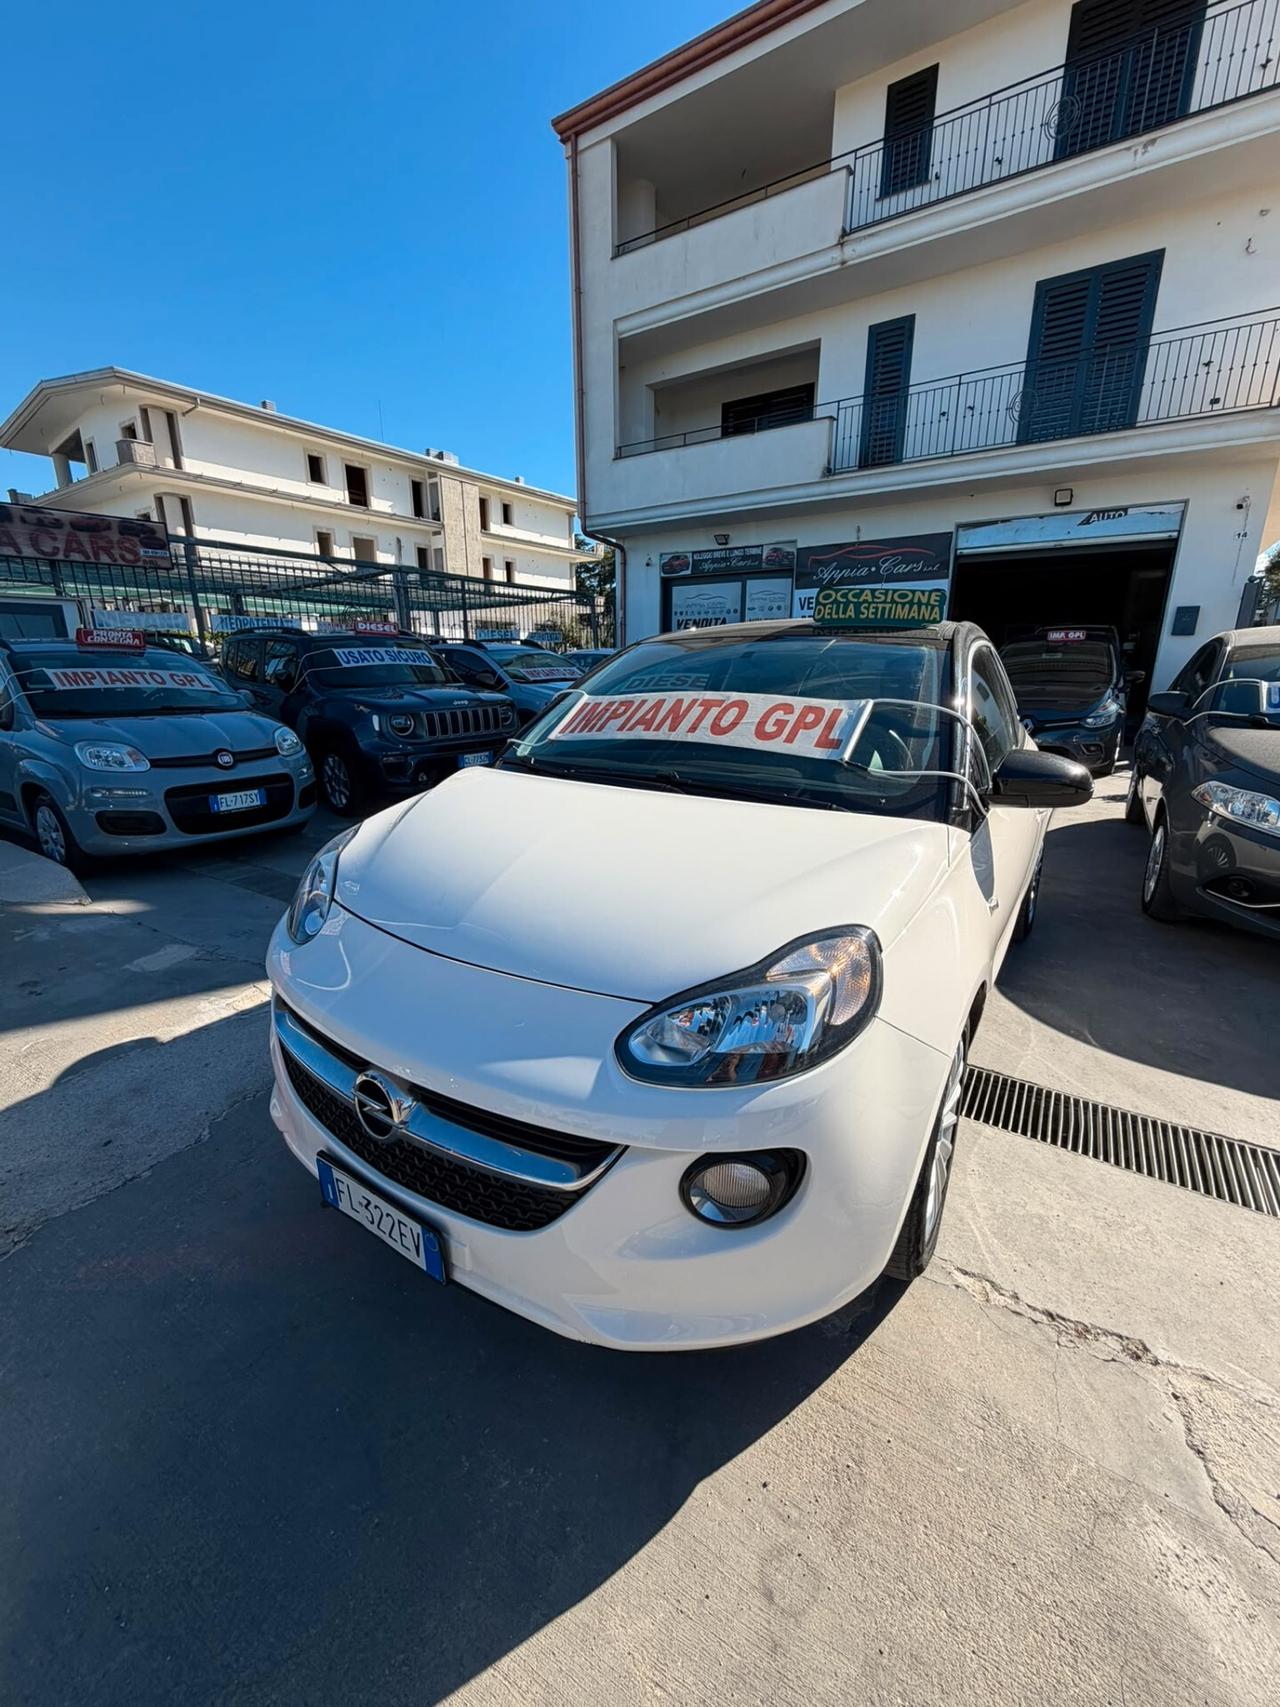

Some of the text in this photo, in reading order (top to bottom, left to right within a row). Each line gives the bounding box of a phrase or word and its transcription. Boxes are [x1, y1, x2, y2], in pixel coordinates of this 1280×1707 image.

[1236, 531, 1248, 539] 14
[30, 529, 141, 564] CARS
[813, 562, 870, 585] Appia
[879, 556, 924, 575] Cars
[818, 589, 942, 605] OCCASIONE
[815, 602, 941, 621] DELLA SETTIMANA
[358, 622, 397, 632] DIESEL
[677, 617, 727, 629] VENDITA
[87, 636, 140, 645] CONSEGNA
[93, 630, 133, 639] PRONTA
[336, 649, 433, 665] USATO SICURO
[52, 671, 212, 689] IMPIANTO GPL
[559, 698, 844, 750] IMPIANTO GPL
